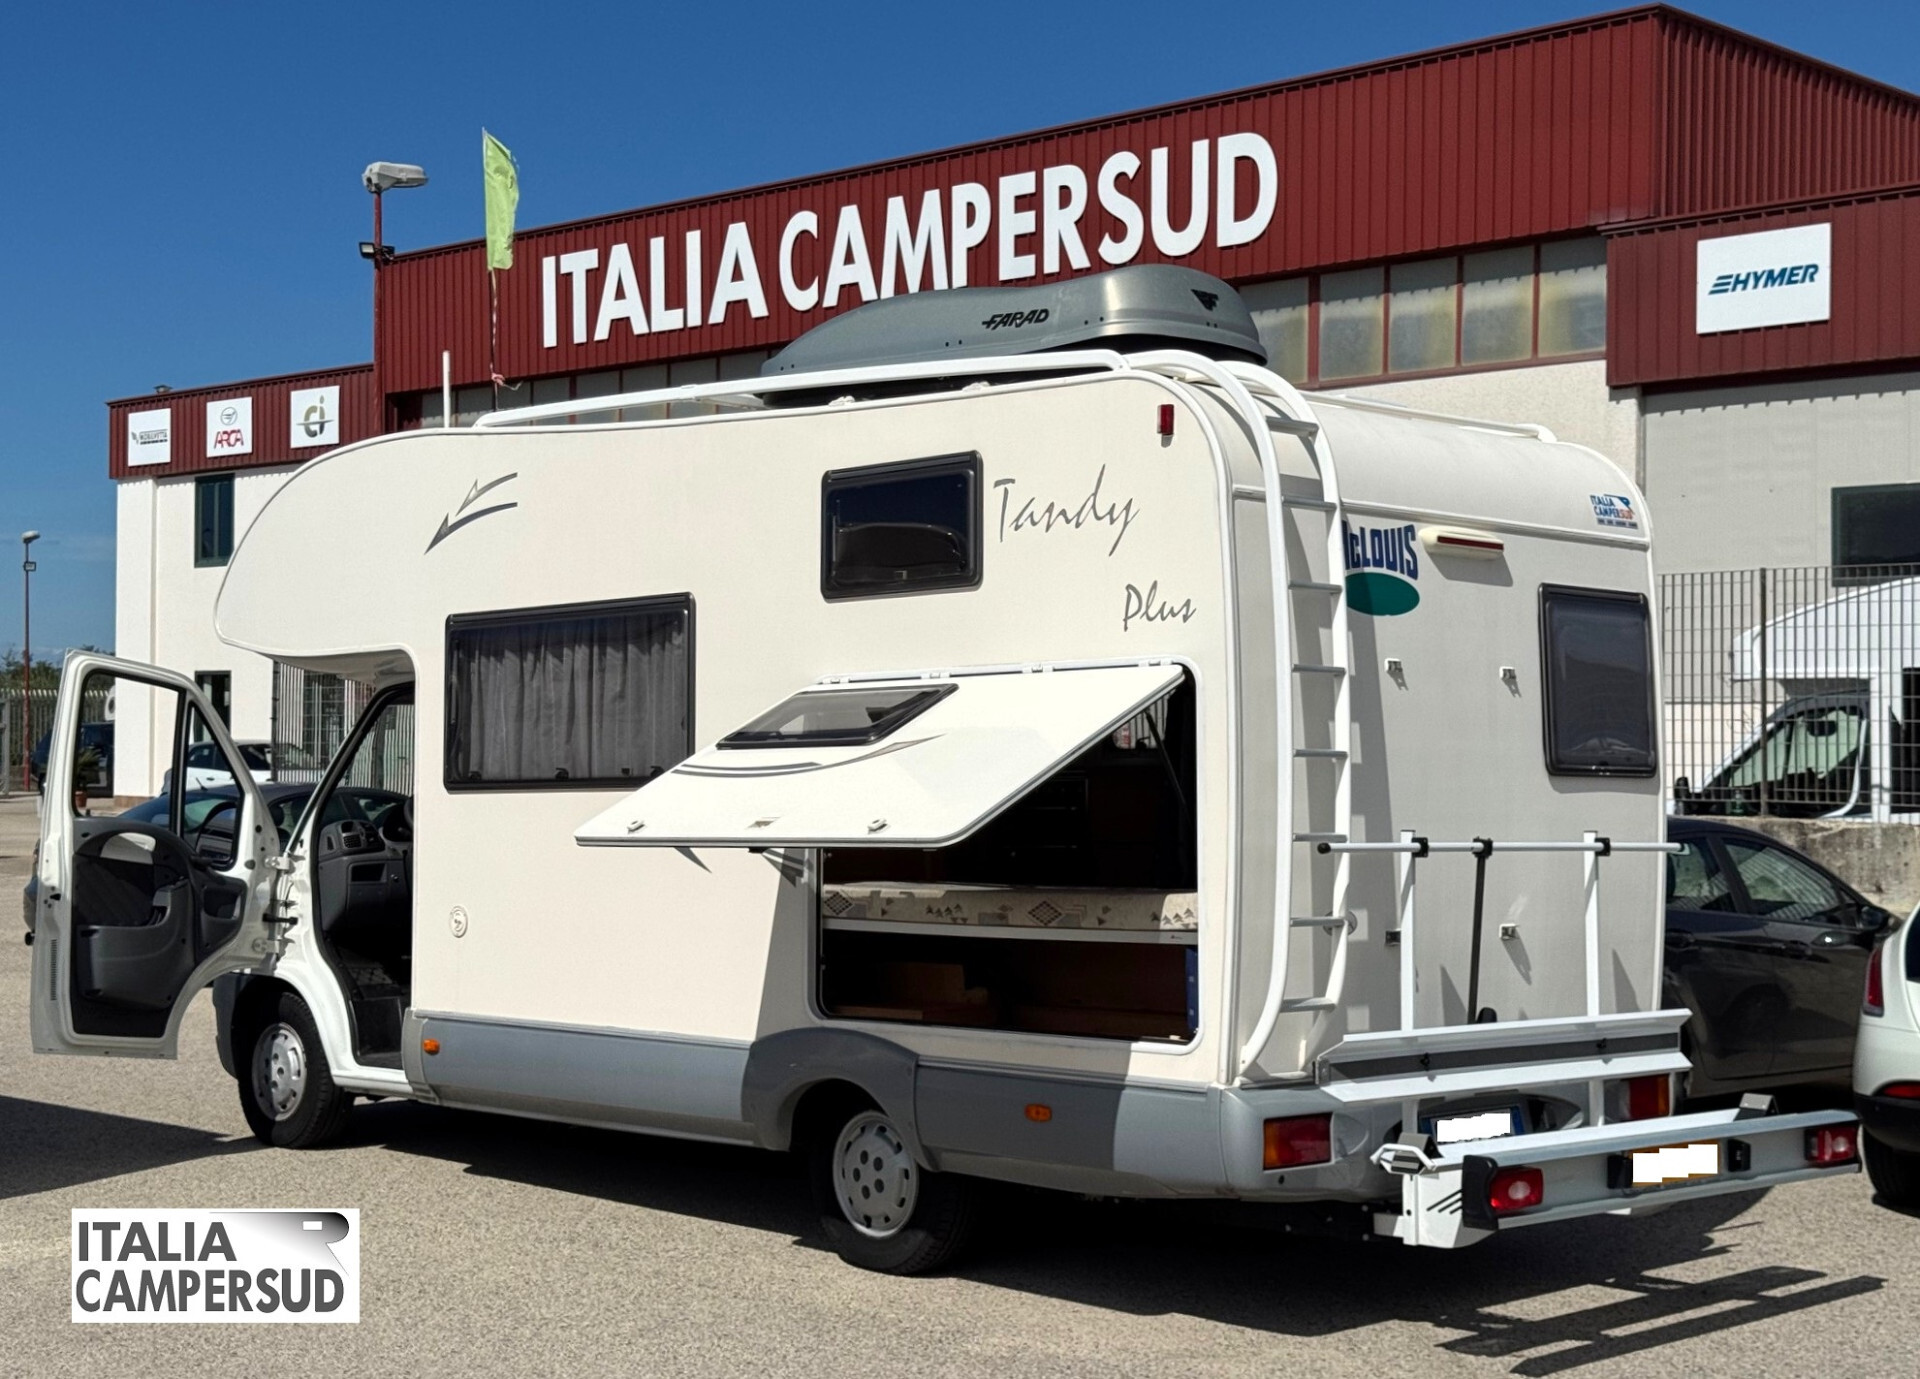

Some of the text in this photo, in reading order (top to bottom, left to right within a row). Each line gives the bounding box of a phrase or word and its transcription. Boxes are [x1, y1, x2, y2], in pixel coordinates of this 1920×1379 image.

[542, 132, 1278, 348] ITALIA CAMPERSUD
[1730, 263, 1819, 293] HYMER
[982, 308, 1049, 331] FARAD
[214, 429, 244, 449] ARCA
[993, 464, 1140, 557] Tandy
[1123, 580, 1197, 632] Plus
